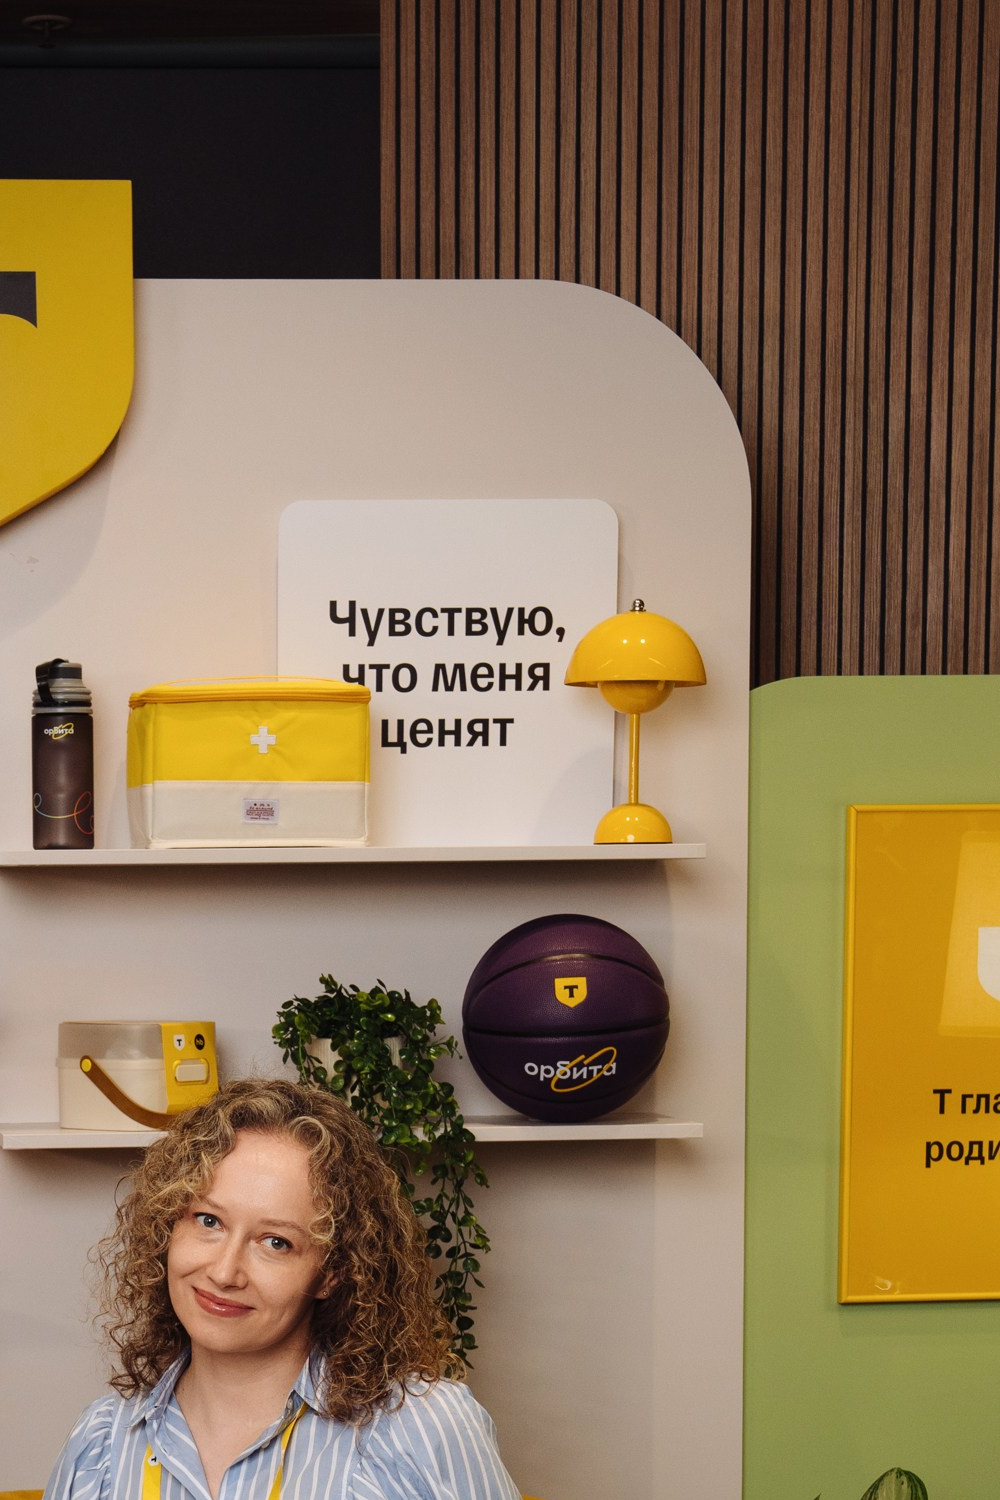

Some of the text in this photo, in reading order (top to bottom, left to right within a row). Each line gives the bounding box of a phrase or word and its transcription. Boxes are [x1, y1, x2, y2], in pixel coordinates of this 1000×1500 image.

[329, 600, 566, 647] Чувствую,
[342, 662, 551, 693] что меня
[43, 725, 75, 737] орбита
[380, 717, 515, 755] ценят
[523, 1060, 617, 1082] орбита
[932, 1088, 953, 1115] Т
